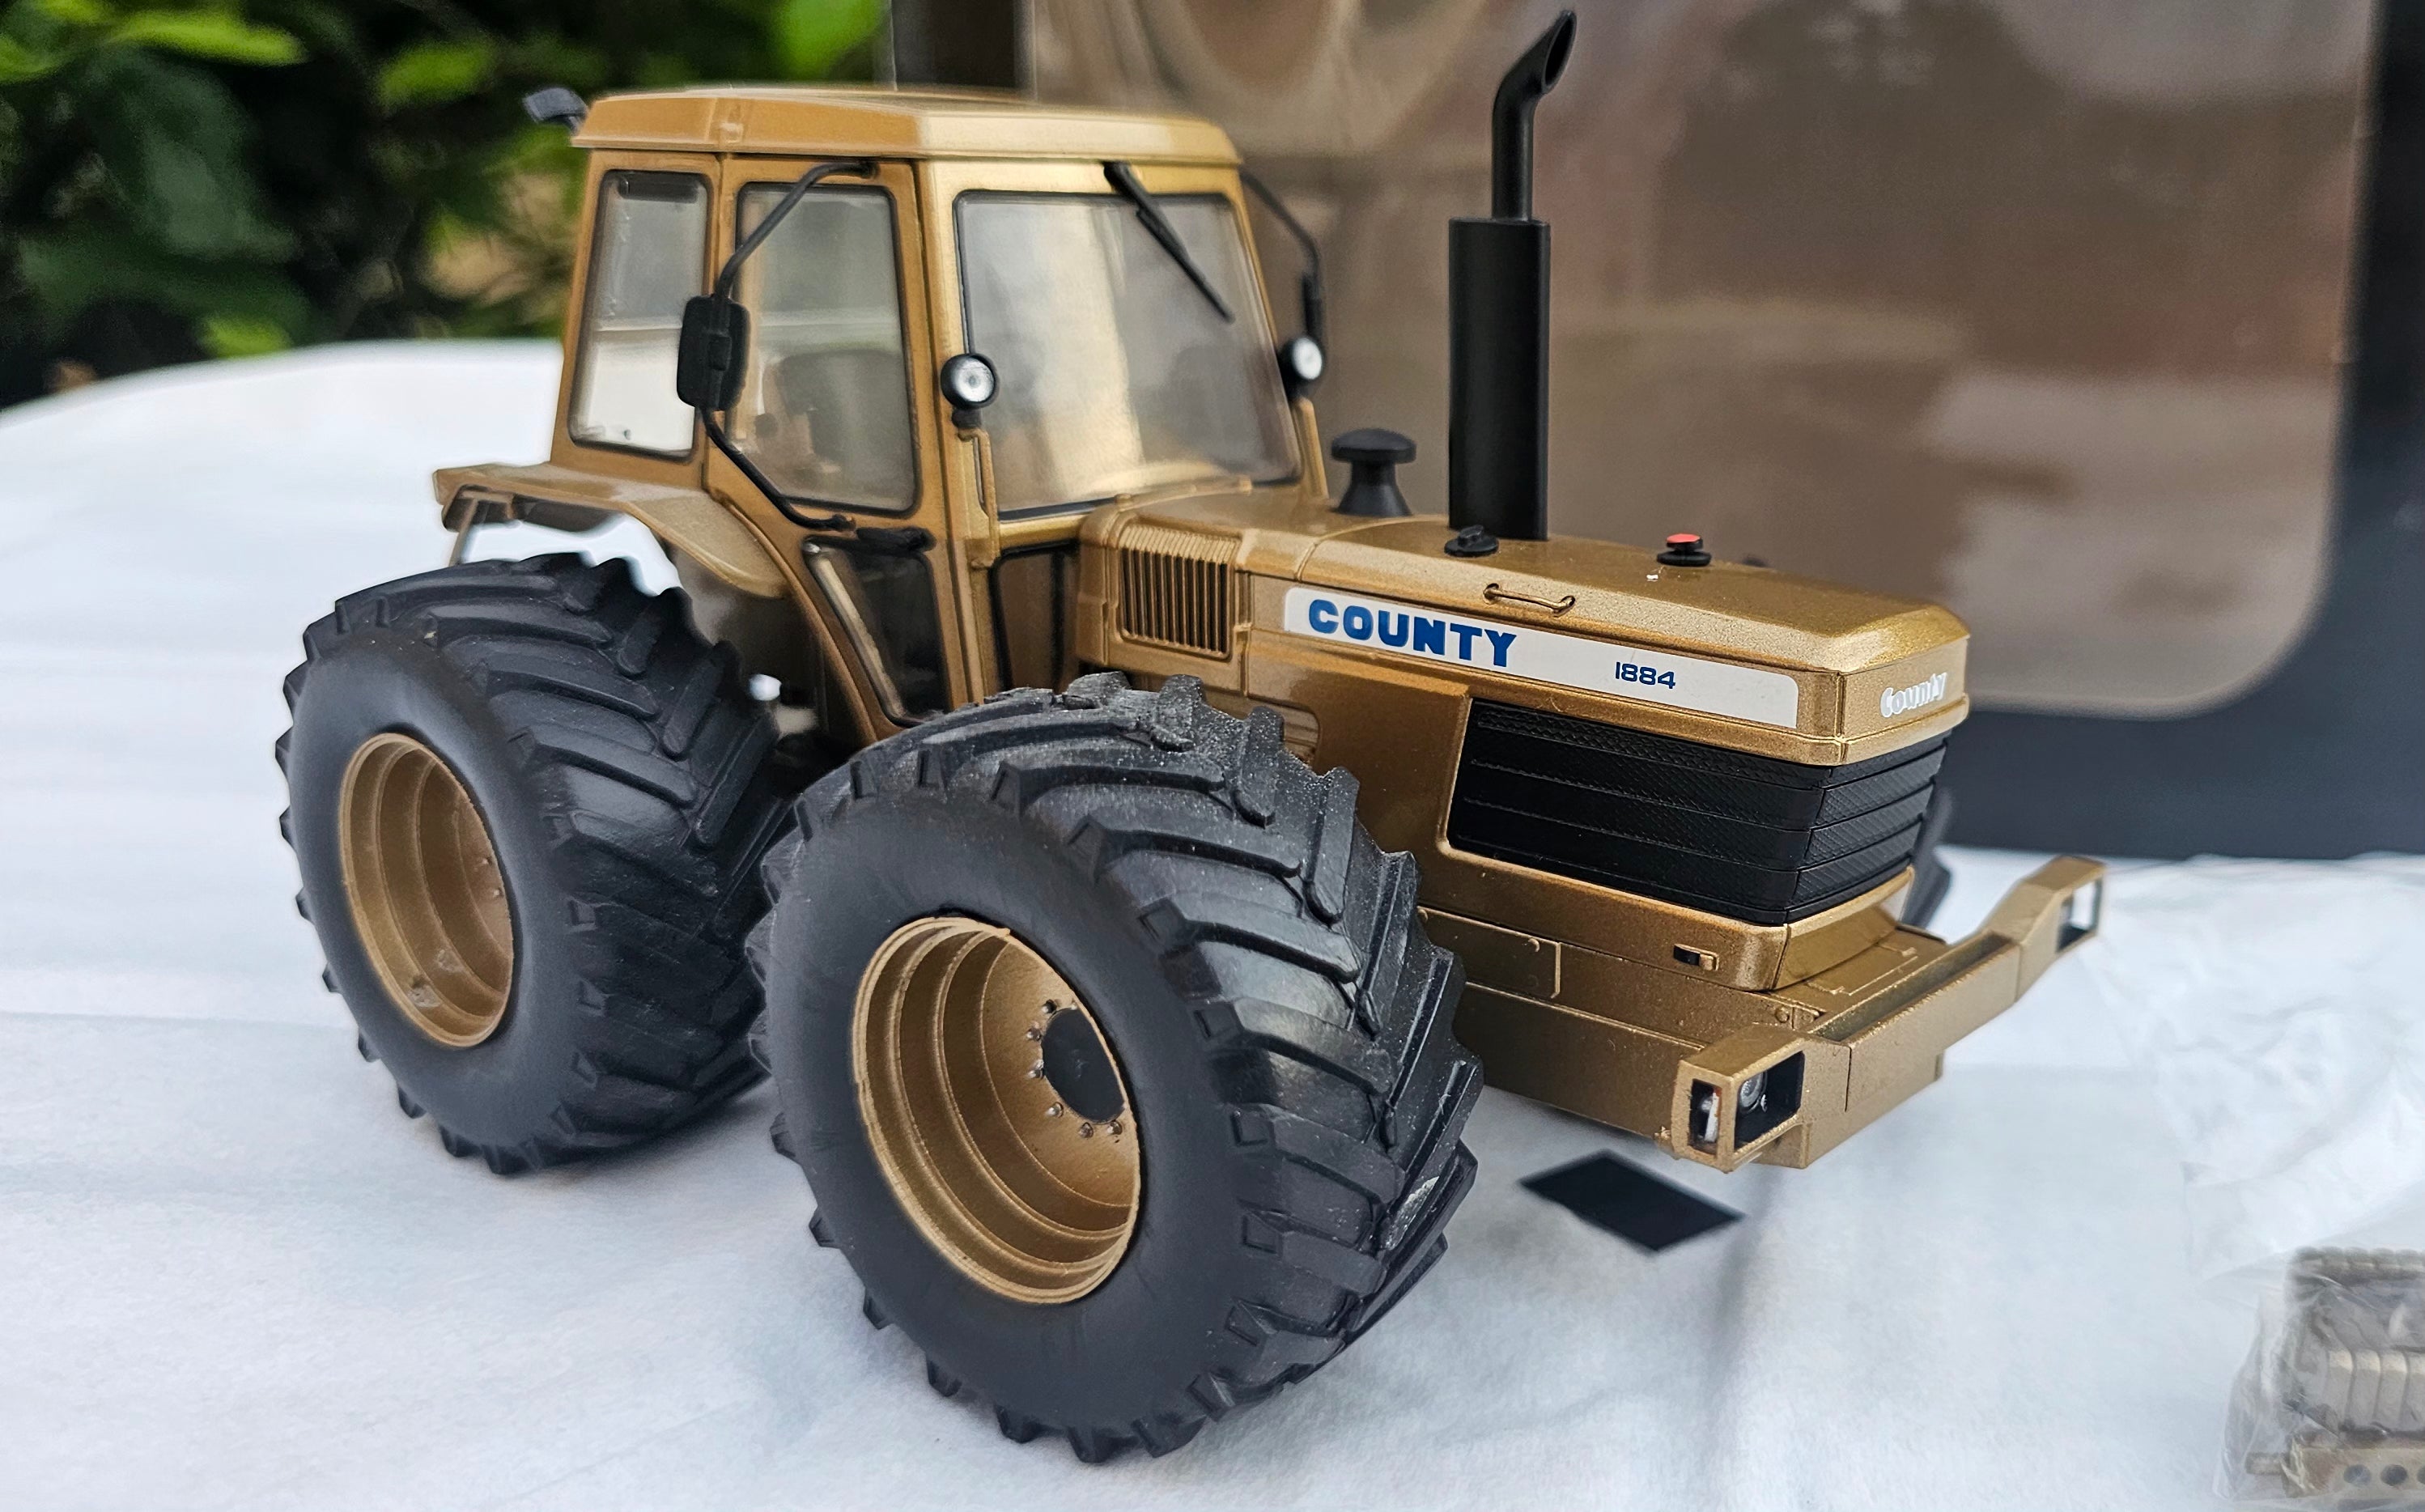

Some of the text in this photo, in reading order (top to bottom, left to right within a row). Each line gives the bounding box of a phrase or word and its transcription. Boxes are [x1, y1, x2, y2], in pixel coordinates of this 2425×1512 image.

[1308, 599, 1517, 667] COUNTY
[1616, 661, 1675, 689] 1884
[1879, 672, 1947, 718] County
